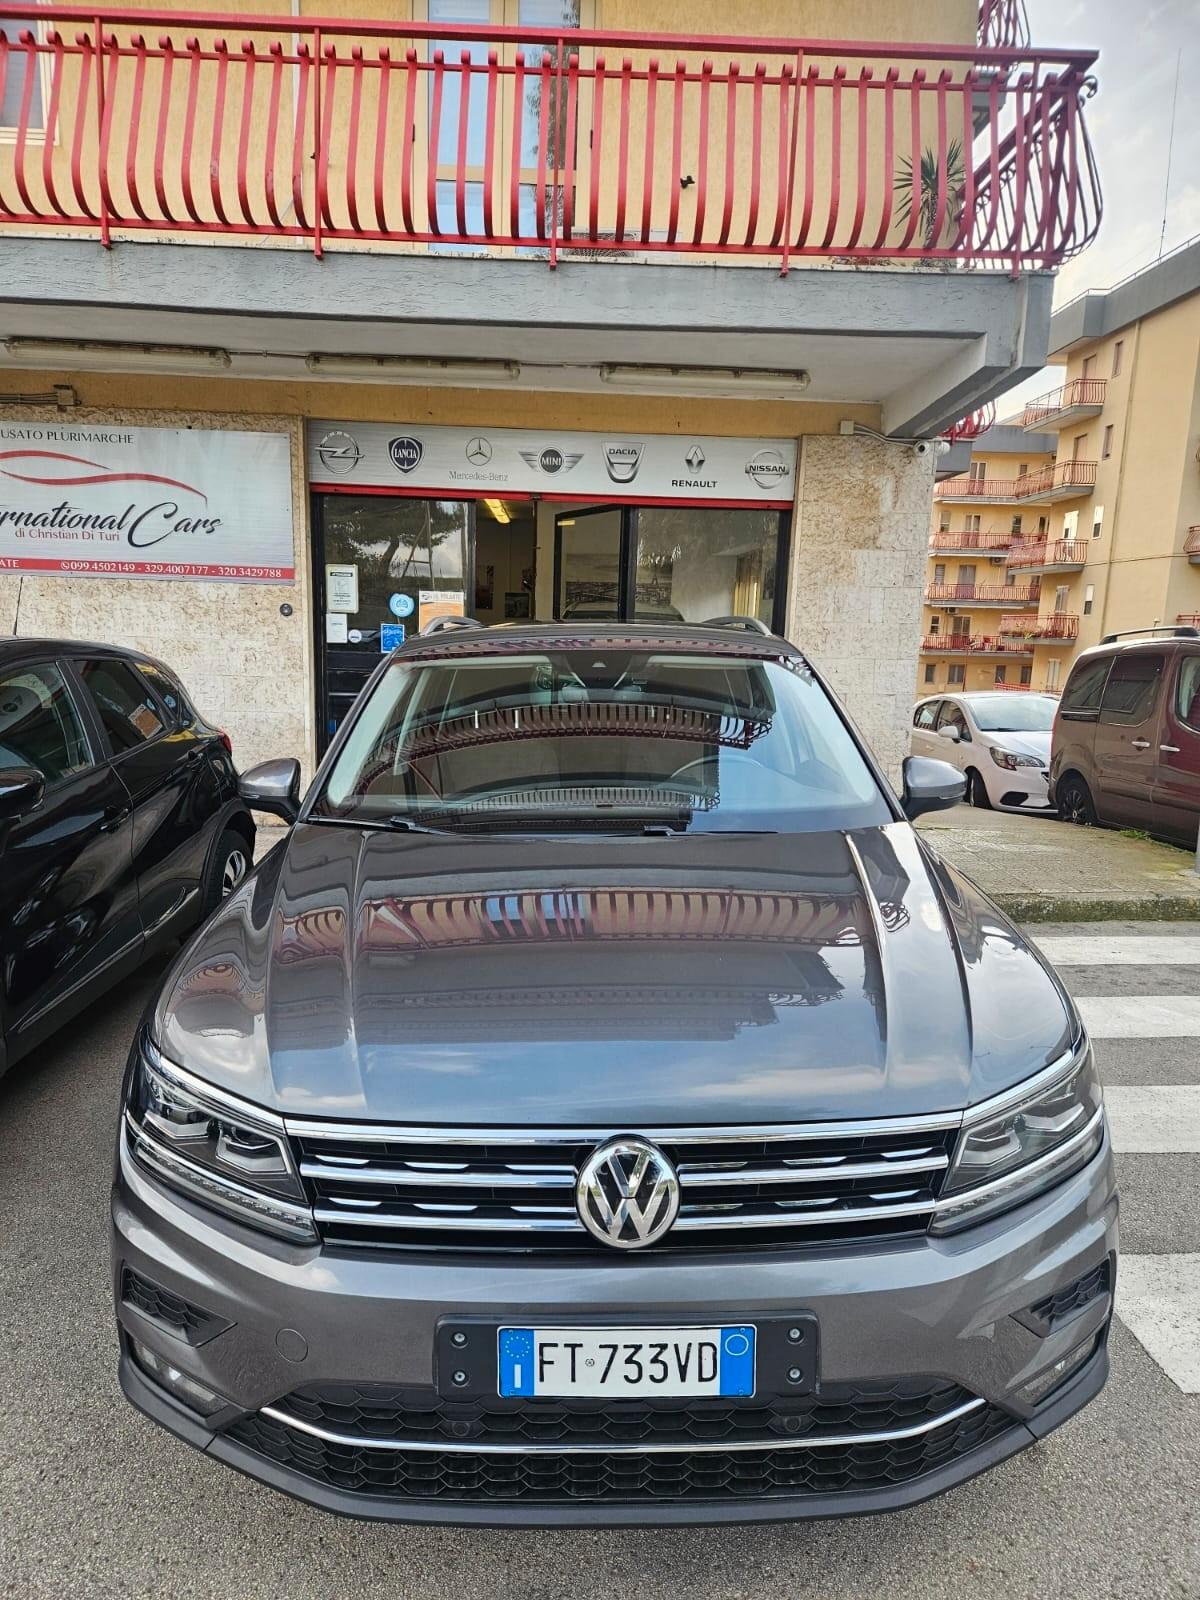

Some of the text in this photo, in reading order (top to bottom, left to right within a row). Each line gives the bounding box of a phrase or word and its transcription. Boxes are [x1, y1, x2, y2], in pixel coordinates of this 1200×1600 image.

[0, 429, 135, 444] USATO PLURIMARCHE
[394, 448, 418, 459] LANCIA
[608, 448, 638, 456] DACIA
[541, 456, 562, 467] MINI
[748, 464, 786, 473] NISSAN
[449, 470, 509, 482] Mercedes-Benz
[671, 479, 718, 489] RENAULT
[128, 501, 224, 548] Cars
[15, 528, 121, 542] di Christian Di Turi
[70, 561, 136, 573] 099.4502149
[144, 563, 209, 575] 329.4007177
[218, 566, 282, 578] 320.3429788
[538, 1341, 719, 1384] FT 733VD
